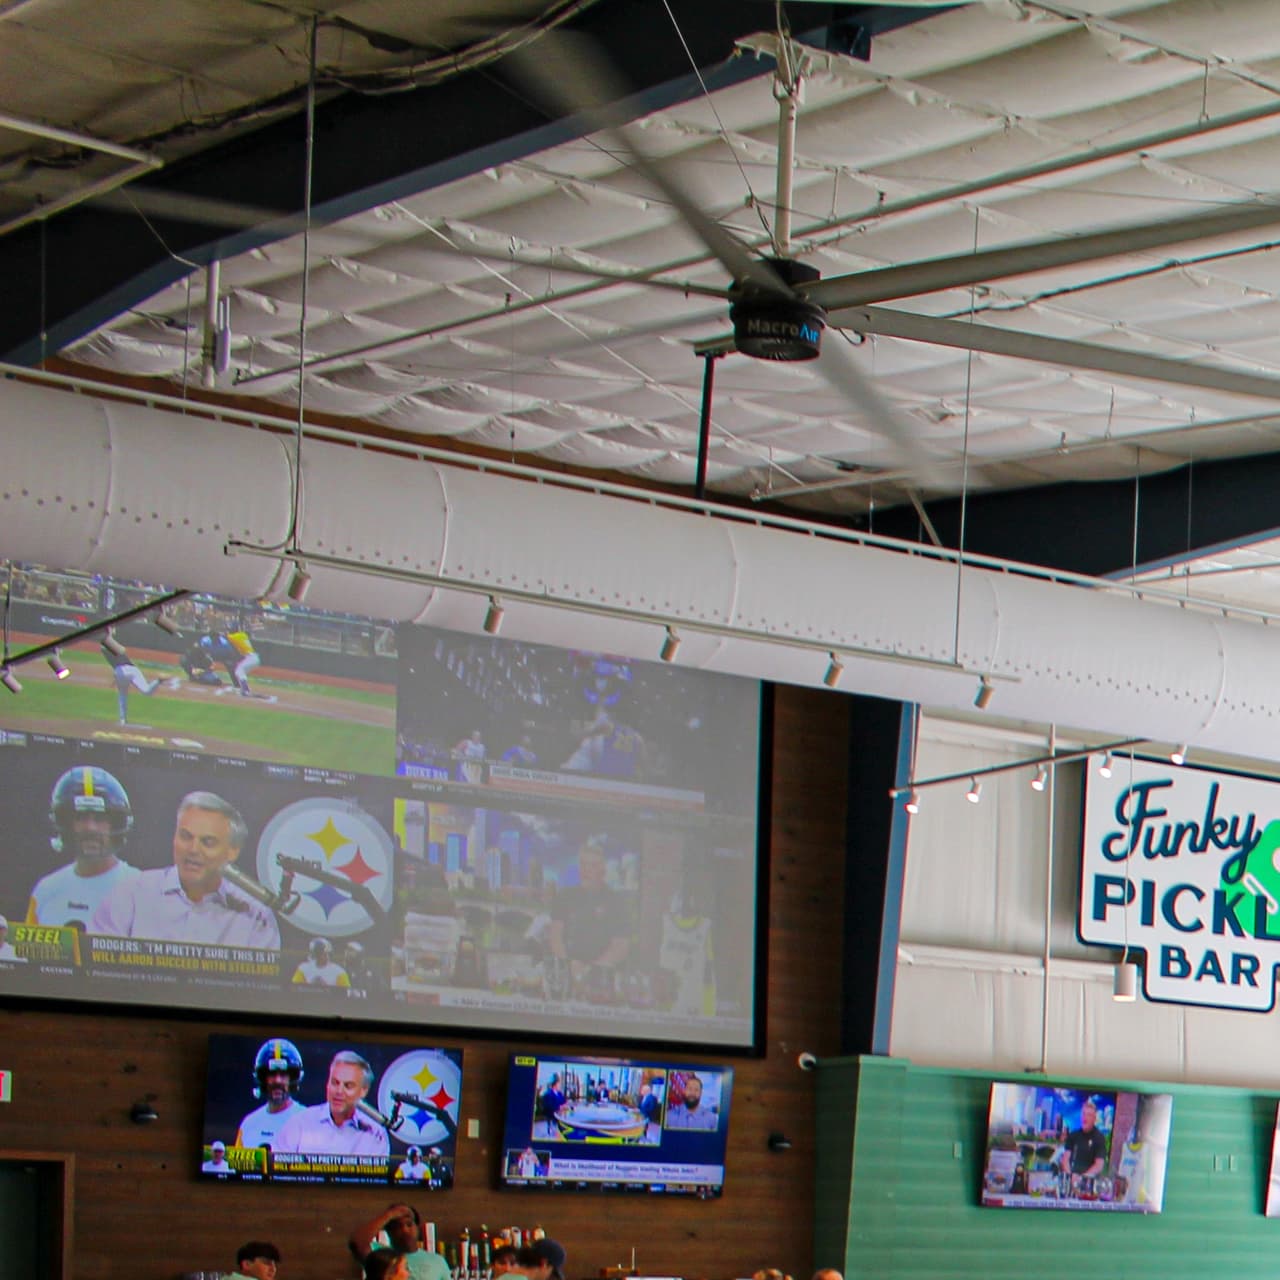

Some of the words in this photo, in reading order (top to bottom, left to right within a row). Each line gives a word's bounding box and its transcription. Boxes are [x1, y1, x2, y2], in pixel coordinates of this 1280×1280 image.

[747, 320, 821, 344] MacroAir
[1101, 778, 1263, 885] Funky
[16, 927, 60, 944] STEEL
[92, 951, 116, 964] WILL
[166, 944, 203, 958] PRETTY
[205, 947, 229, 960] SURE
[232, 949, 254, 961] THIS
[1159, 944, 1261, 987] BAR
